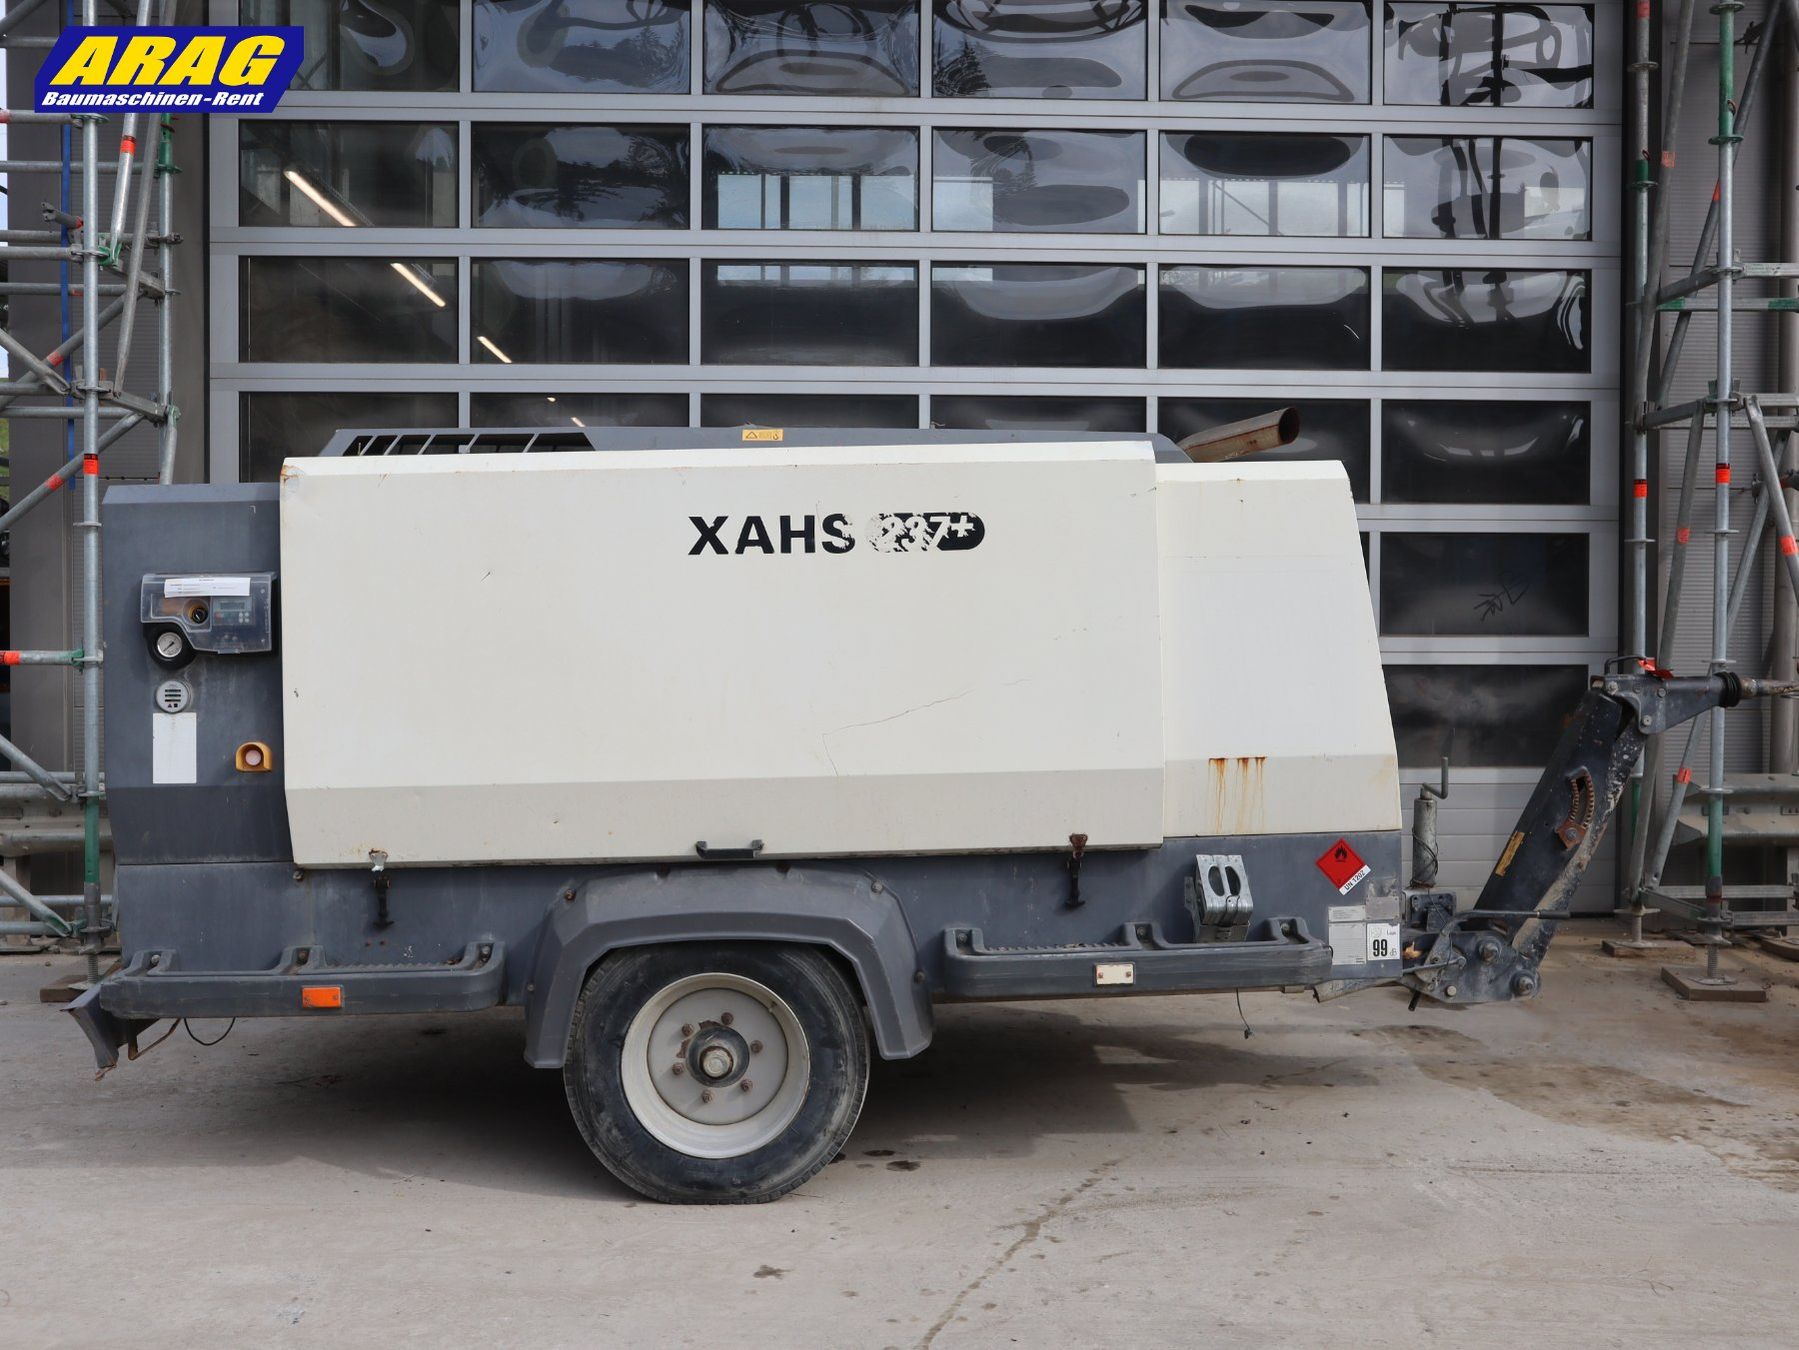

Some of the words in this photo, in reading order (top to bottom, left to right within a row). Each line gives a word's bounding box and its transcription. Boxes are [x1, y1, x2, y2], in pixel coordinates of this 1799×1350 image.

[688, 513, 855, 555] XAHS
[1344, 882, 1353, 891] UN
[1352, 870, 1366, 883] 1202
[1373, 939, 1387, 957] 99
